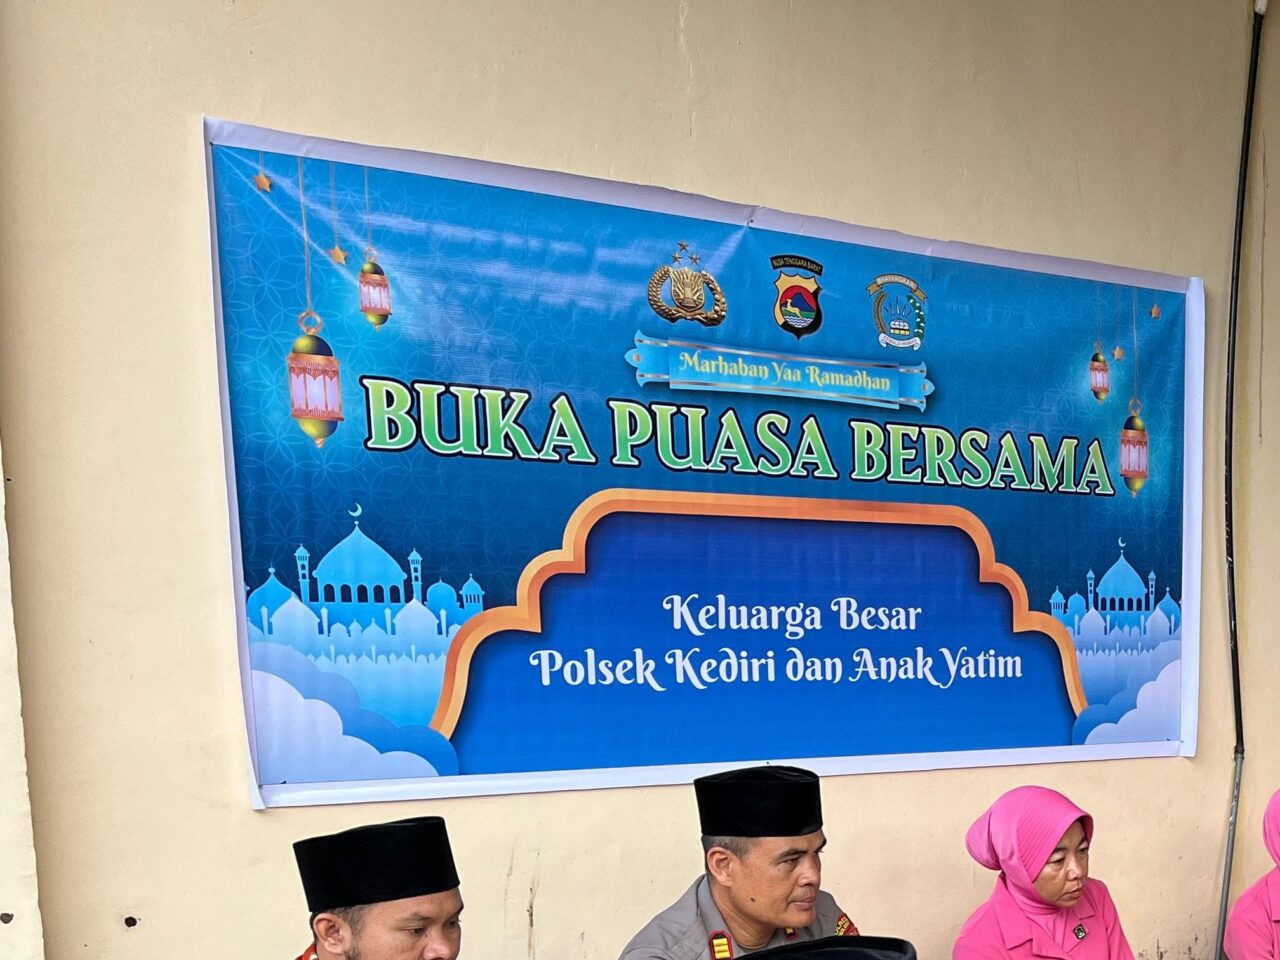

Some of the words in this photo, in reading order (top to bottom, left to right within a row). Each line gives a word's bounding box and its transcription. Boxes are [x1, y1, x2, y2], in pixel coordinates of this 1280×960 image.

[680, 350, 769, 379] Marhaban
[771, 361, 801, 386] Yaa
[806, 366, 891, 392] Ramadhan
[360, 376, 599, 465] BUKA
[608, 398, 839, 479] PUASA
[850, 419, 1116, 496] BERSAMA
[662, 594, 823, 640] Keluarga
[831, 597, 922, 630] Besar
[529, 648, 667, 692] Polsek
[665, 648, 776, 689] Kediri
[786, 647, 843, 684] dan
[849, 647, 942, 687] Anak
[938, 646, 1023, 689] Yatim
